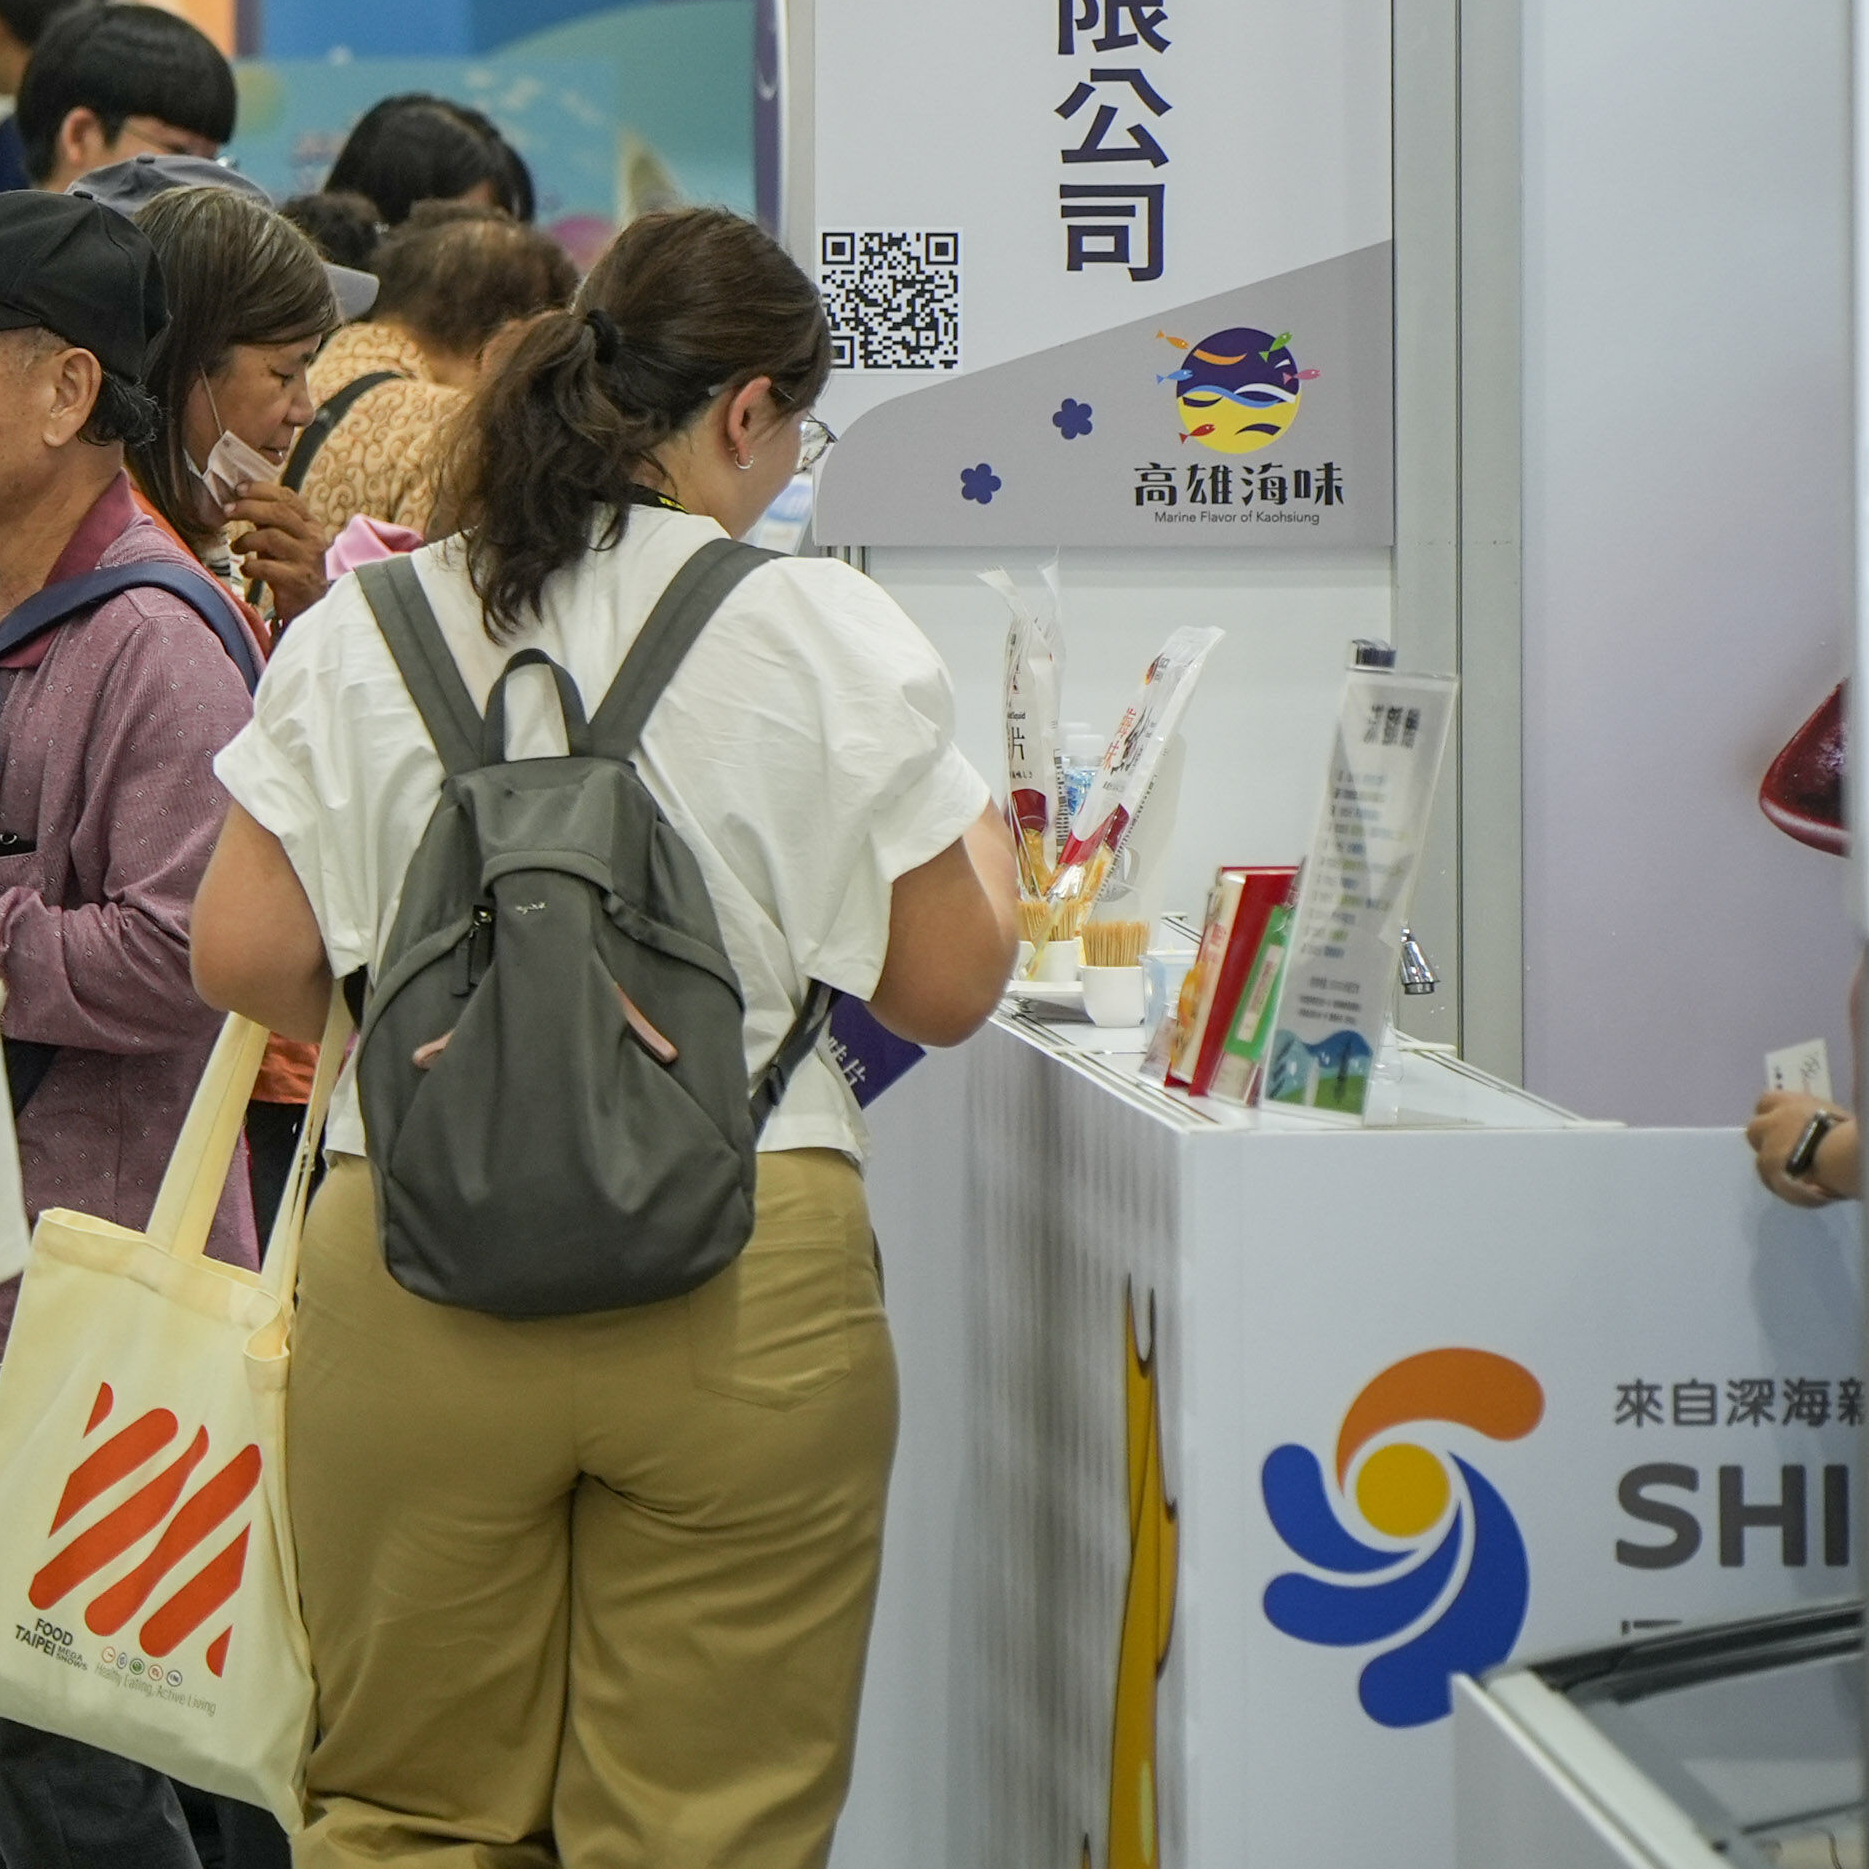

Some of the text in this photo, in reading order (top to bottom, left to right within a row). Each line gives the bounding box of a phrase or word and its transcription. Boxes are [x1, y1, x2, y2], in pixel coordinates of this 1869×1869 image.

[1134, 461, 1344, 506] 高雄海味
[1155, 510, 1320, 525] Marine Flavor of Kaohsiung
[1616, 1462, 1849, 1570] SHI
[15, 1625, 56, 1657] TAIPEI
[36, 1618, 74, 1646] FOOD
[55, 1652, 88, 1671] SHOWS
[57, 1646, 83, 1662] MEGA
[94, 1662, 123, 1687] Healthy
[156, 1684, 186, 1706] Active
[187, 1693, 217, 1717] Living
